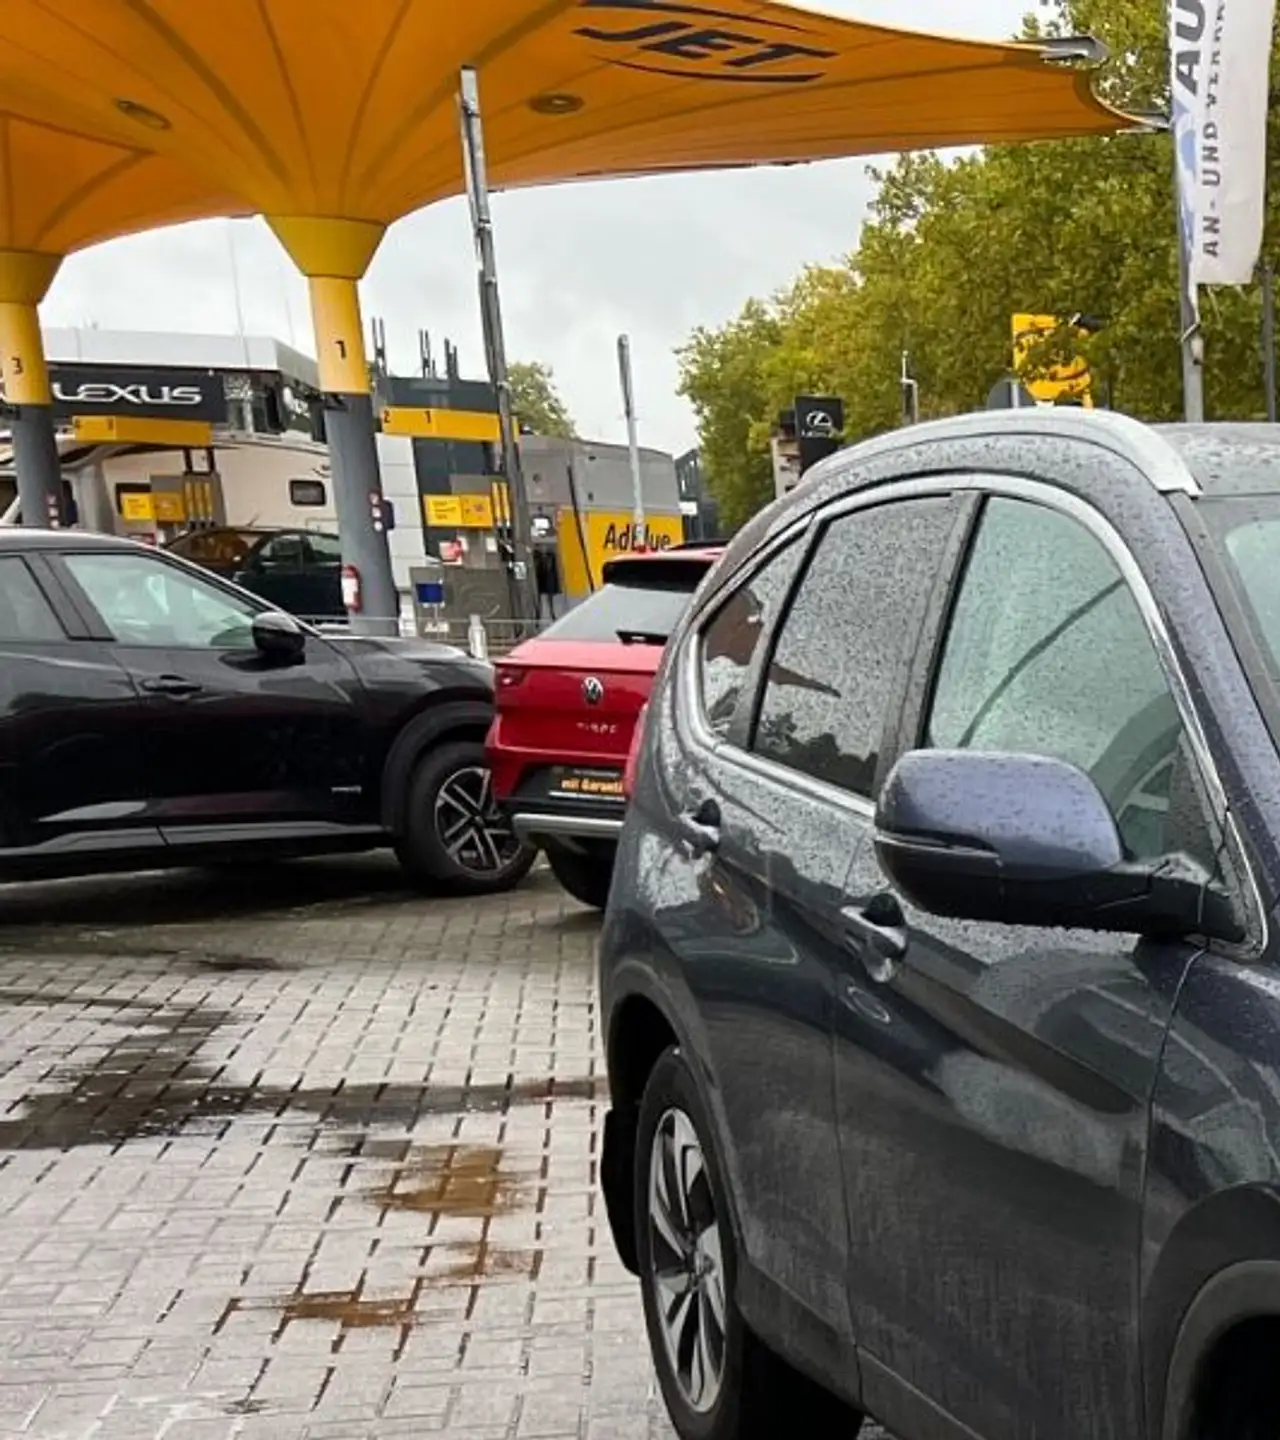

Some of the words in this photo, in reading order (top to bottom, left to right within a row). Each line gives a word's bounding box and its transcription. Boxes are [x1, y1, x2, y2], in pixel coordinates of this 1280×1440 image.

[571, 21, 840, 67] JET
[1202, 121, 1221, 187] UND
[52, 381, 203, 405] LEXUS
